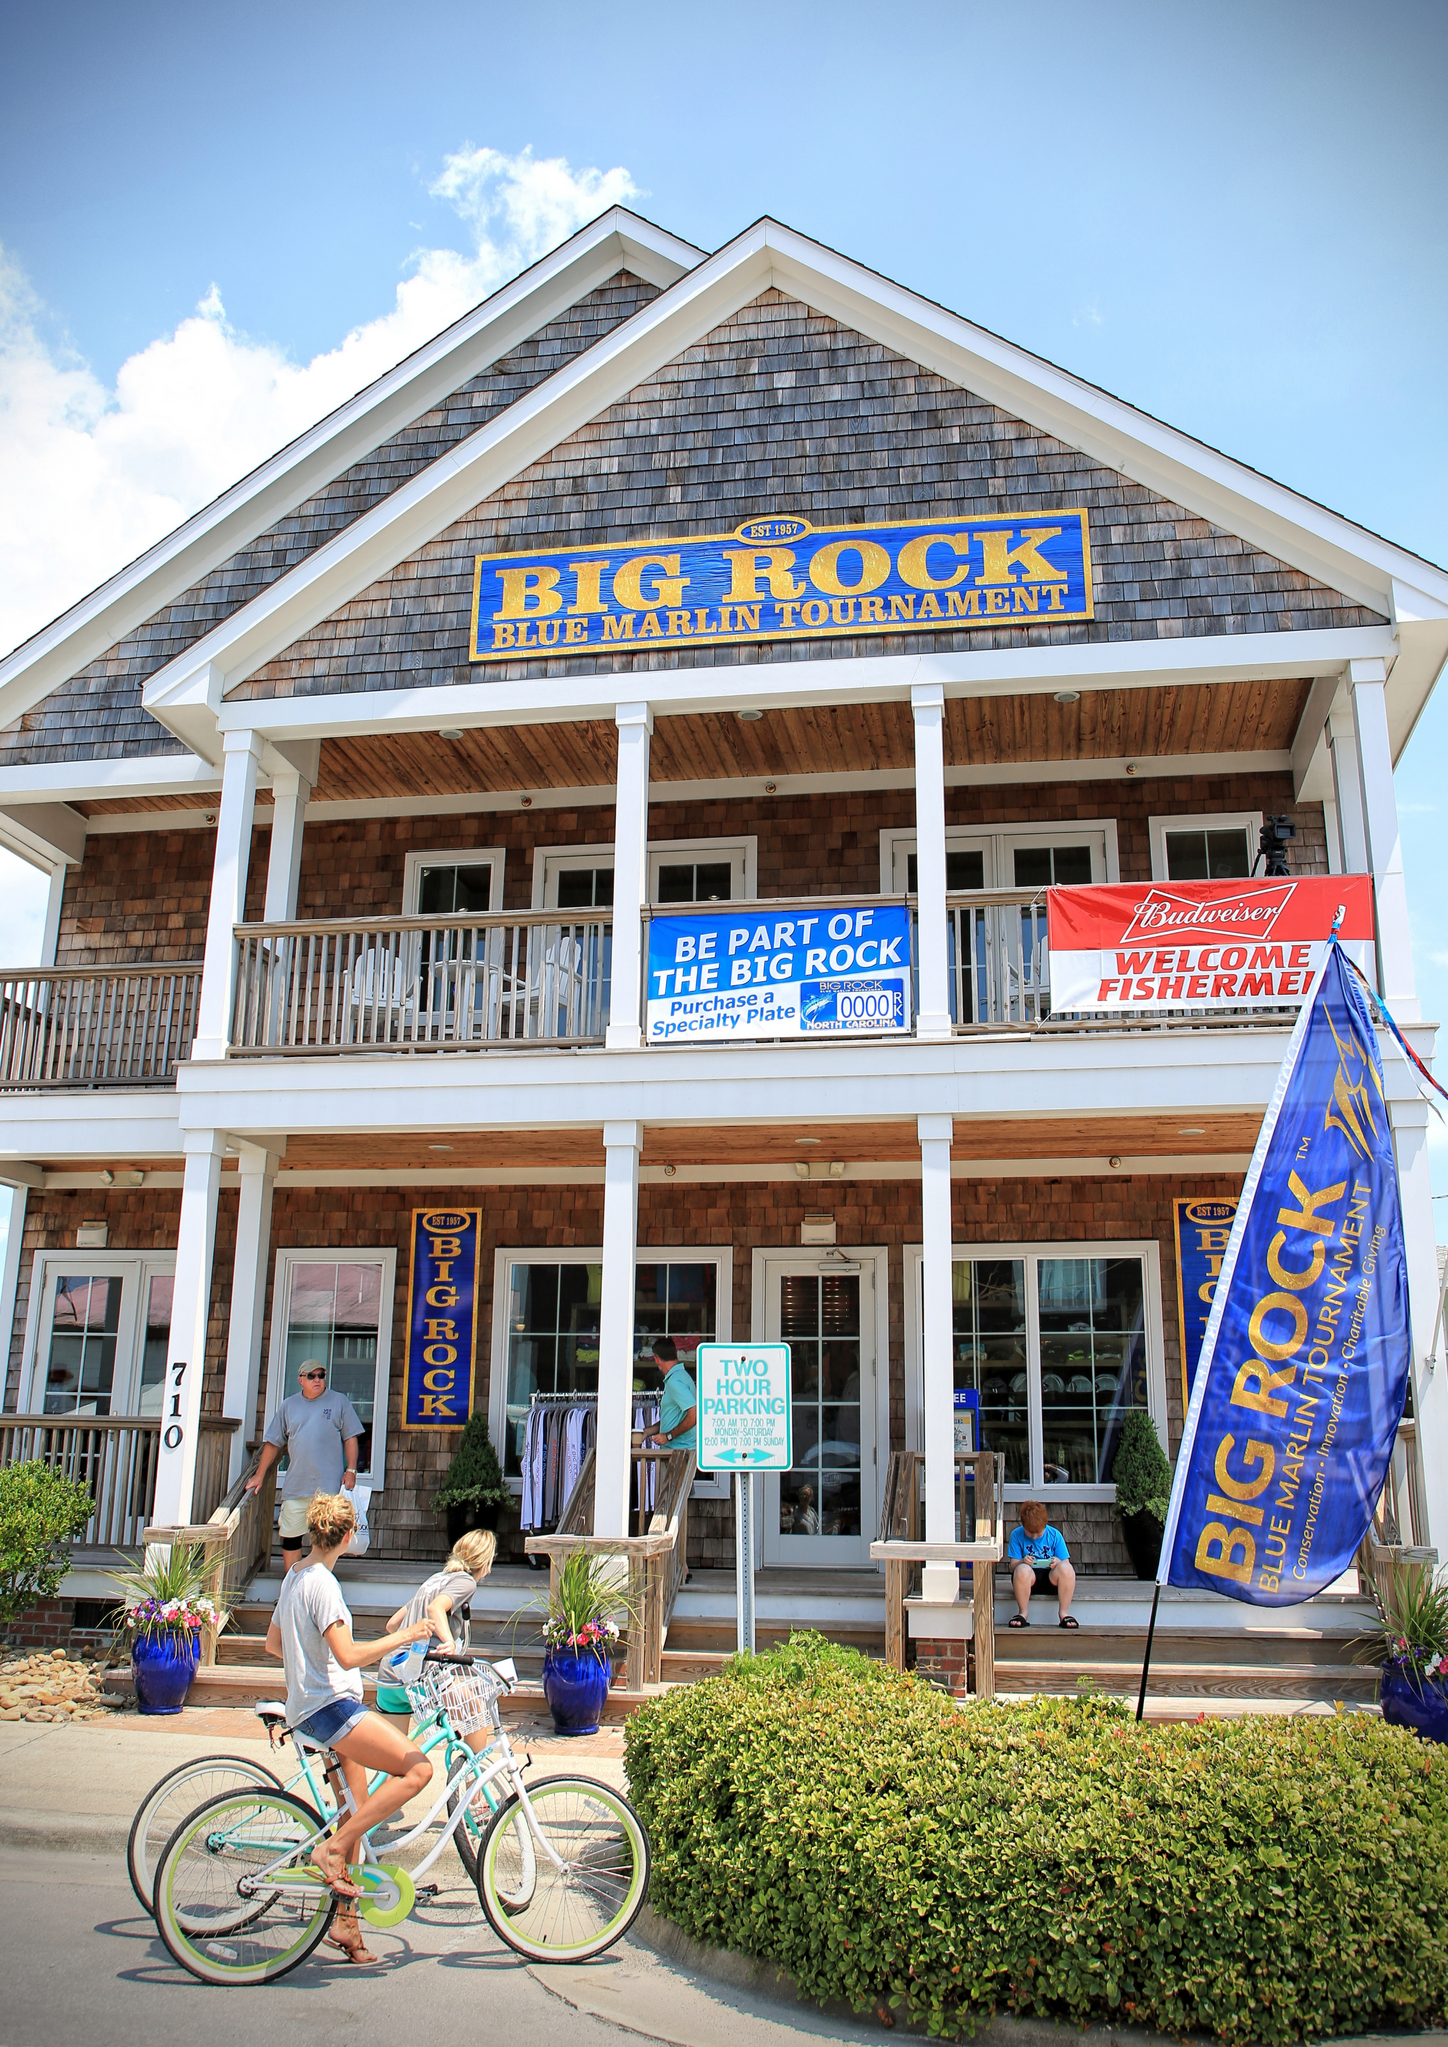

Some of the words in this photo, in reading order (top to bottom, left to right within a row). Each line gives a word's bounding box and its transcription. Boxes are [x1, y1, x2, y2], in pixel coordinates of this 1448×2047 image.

[751, 525, 771, 537] EST
[775, 523, 798, 536] 1957
[492, 553, 690, 621] BIG
[722, 527, 1068, 603] ROCK
[491, 617, 588, 649] BLUE
[601, 605, 762, 641] MARLIN
[775, 584, 1068, 628] TOURNAMENT
[1133, 900, 1281, 930] Budweiser
[674, 932, 718, 964] BE
[728, 917, 819, 956] PART
[827, 910, 875, 941] OF
[653, 963, 720, 997] THE
[730, 952, 794, 987] BIG
[805, 936, 903, 976] ROCK
[1114, 944, 1312, 975] WELCOME
[819, 981, 841, 991] BIG
[843, 980, 883, 991] ROCK
[670, 993, 758, 1016] Purchase
[760, 992, 774, 1005] a
[841, 994, 889, 1018] 0000
[652, 1013, 740, 1038] Specialty
[746, 1005, 796, 1025] Plate
[806, 1020, 843, 1030] NORTH
[846, 1018, 897, 1028] CAROLINA
[432, 1216, 445, 1226] EST
[446, 1216, 461, 1226] 1957
[1196, 1206, 1211, 1216] EST
[1213, 1206, 1230, 1216] 1957
[425, 1236, 462, 1308] BIG
[1302, 1179, 1372, 1383] TOURNAMENT
[1229, 1168, 1348, 1418] ROCK
[418, 1318, 459, 1416] ROCK
[719, 1359, 768, 1377] TWO
[716, 1379, 771, 1396] HOUR
[953, 1393, 966, 1403] EE
[1292, 1471, 1326, 1580] Conservation
[1316, 1376, 1349, 1458] Innovation
[1341, 1277, 1372, 1360] Charitable
[1361, 1224, 1387, 1275] Giving
[164, 1362, 187, 1449] 710
[704, 1397, 785, 1415] PARKING
[712, 1418, 725, 1427] 7:00
[727, 1418, 738, 1427] AM
[740, 1418, 748, 1427] TO
[750, 1418, 764, 1427] 7:00
[766, 1418, 775, 1427] PM
[714, 1427, 774, 1436] MONDAY-SATURDAY
[704, 1437, 718, 1446] 12:00
[720, 1437, 728, 1446] PM
[731, 1437, 738, 1446] TO
[739, 1437, 751, 1446] 7:00
[753, 1437, 761, 1446] PM
[763, 1437, 784, 1446] SUNDAY
[1274, 1393, 1319, 1510] MARLIN
[1194, 1433, 1276, 1585] BIG
[1258, 1515, 1292, 1593] BLUE
[449, 1746, 494, 1791] revolutions
